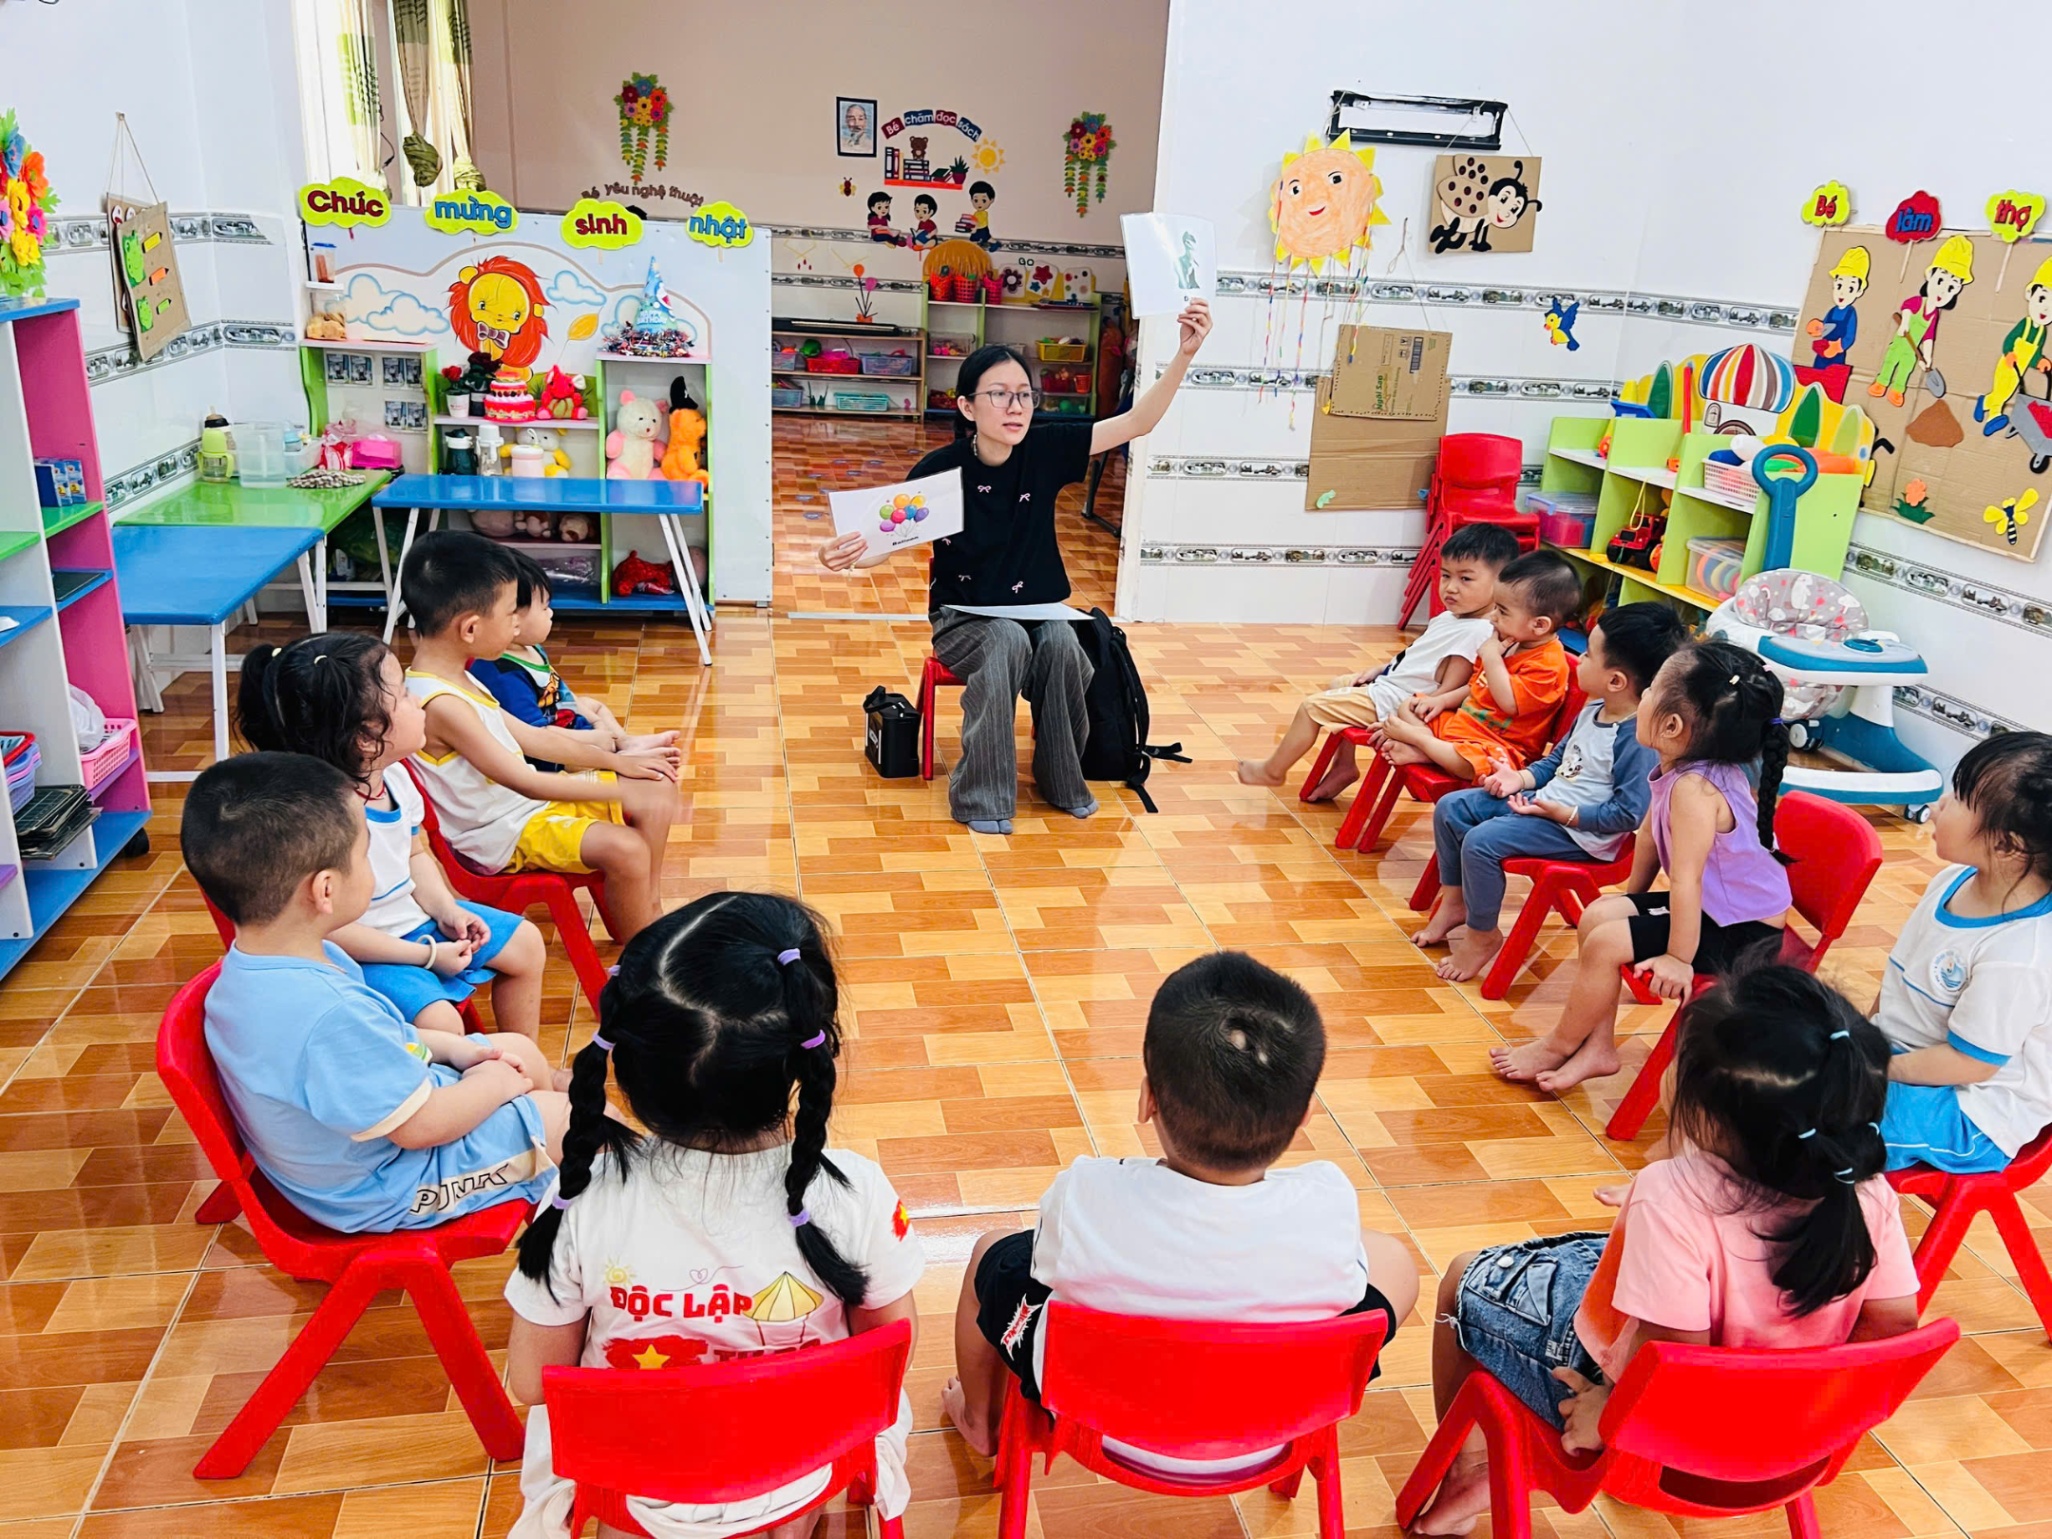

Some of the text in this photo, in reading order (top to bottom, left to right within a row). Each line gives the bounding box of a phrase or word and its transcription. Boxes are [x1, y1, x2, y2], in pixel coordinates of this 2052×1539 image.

[886, 110, 980, 139] Bé chăm đọc sách
[604, 182, 629, 196] yêu
[632, 184, 666, 200] nghệ
[669, 186, 704, 207] thuật
[1814, 194, 1838, 219] Bé
[1994, 199, 2032, 232] thợ
[307, 190, 747, 243] Chúc mừng sinh nhật
[609, 1283, 753, 1323] ĐỘC LẬP
